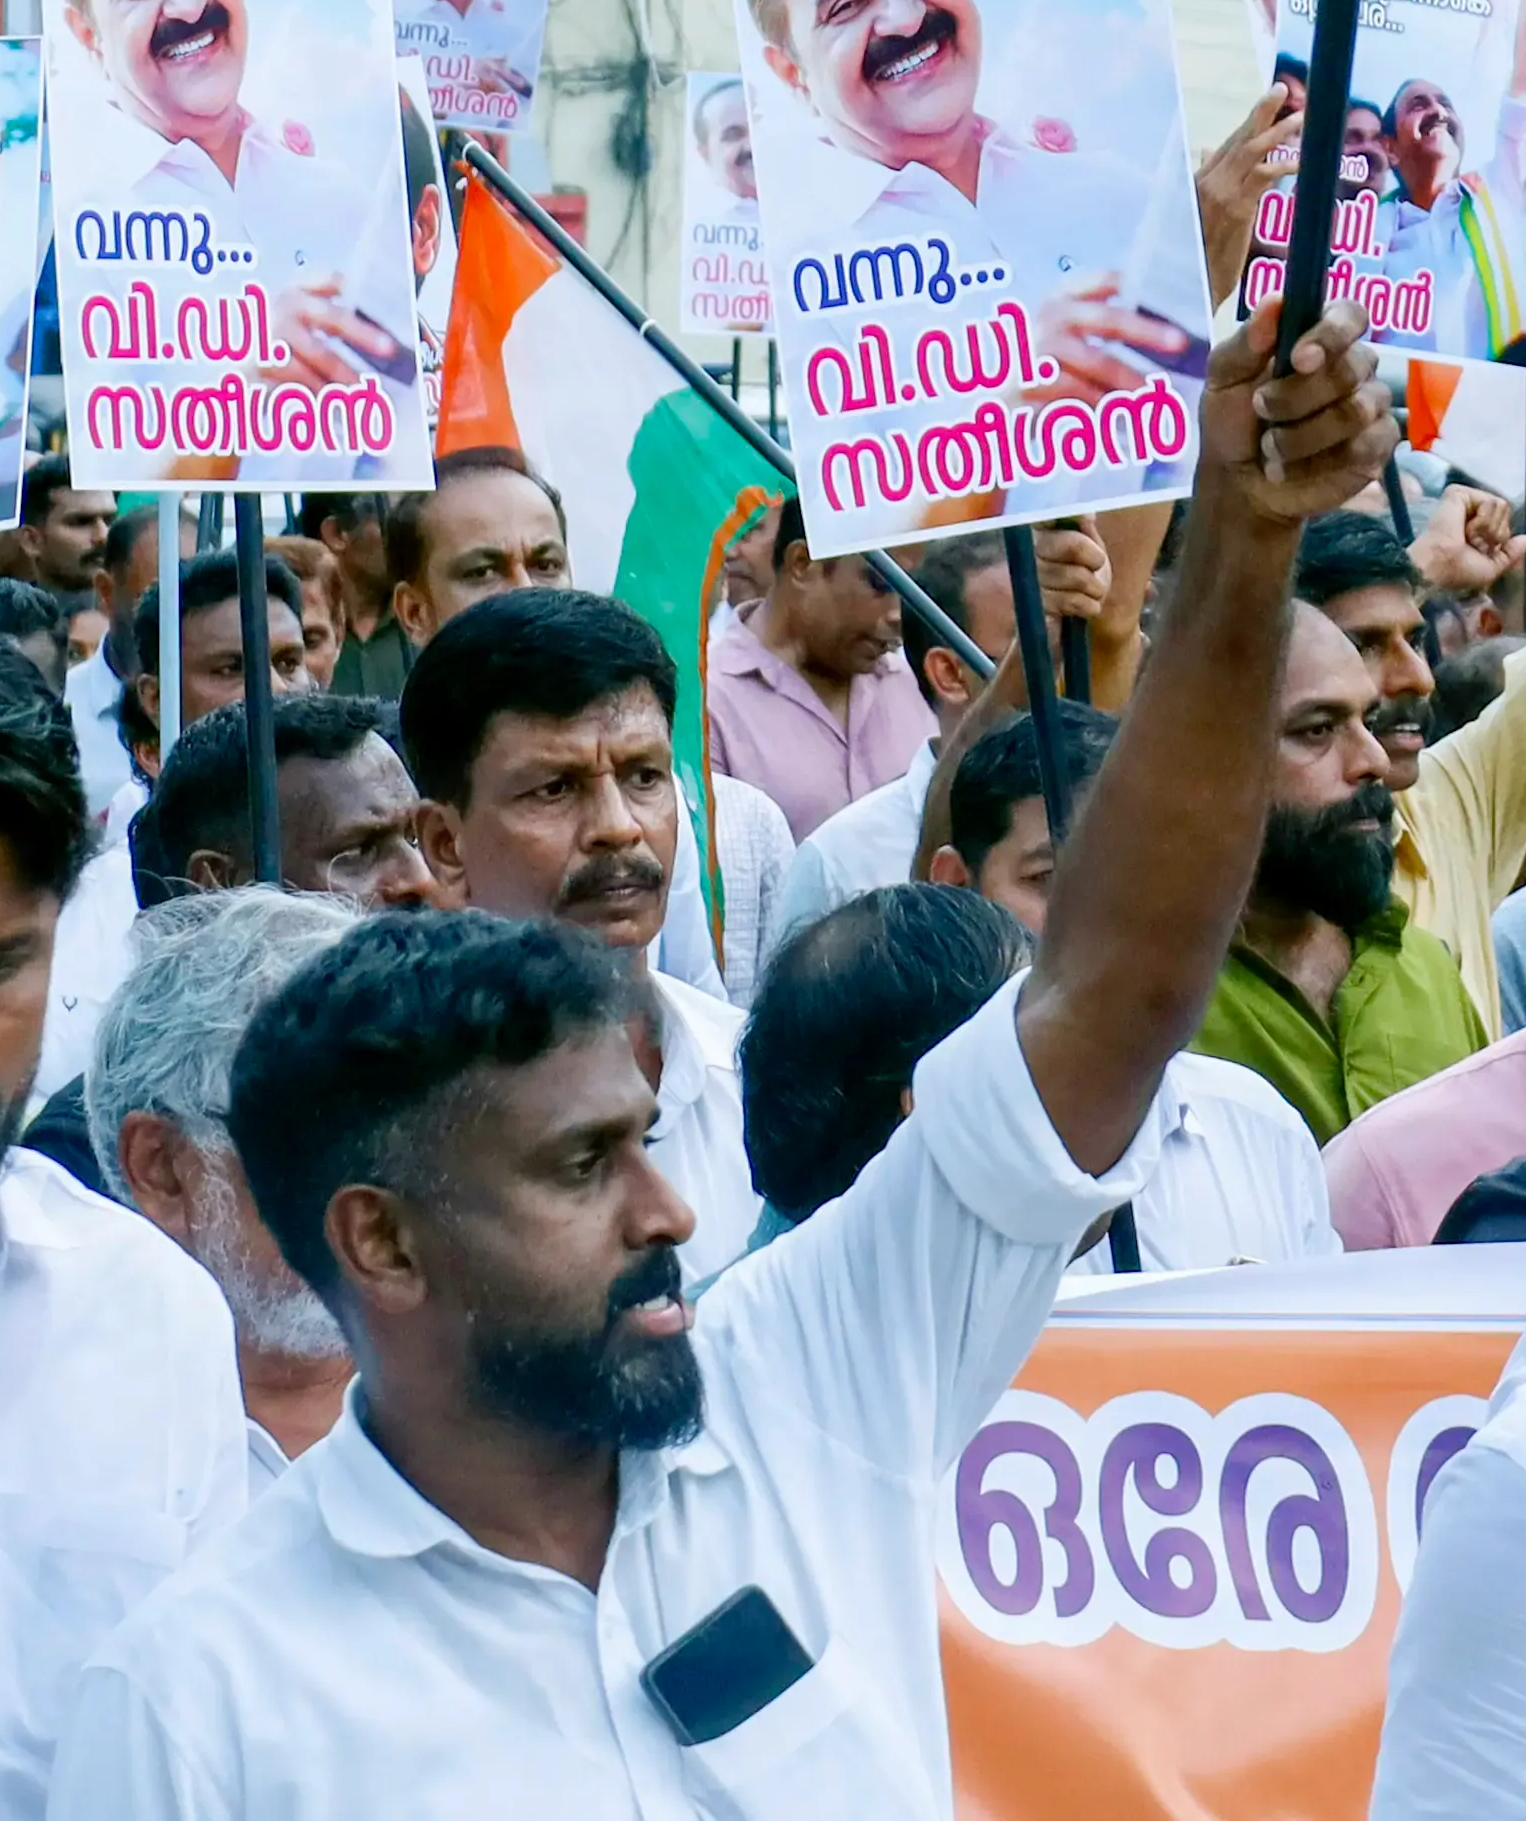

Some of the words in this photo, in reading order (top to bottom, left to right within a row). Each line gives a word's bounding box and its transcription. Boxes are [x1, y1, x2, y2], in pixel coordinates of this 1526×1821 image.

[74, 205, 253, 273] വന്നു...
[792, 237, 1006, 313] വന്നു...
[81, 280, 288, 366] വി.ഡി.
[805, 302, 1059, 418] വി.ഡി.
[87, 368, 393, 456] സതീശൻ
[820, 376, 1188, 512] സതീശൻ
[954, 1417, 1351, 1626] ഒരേ
